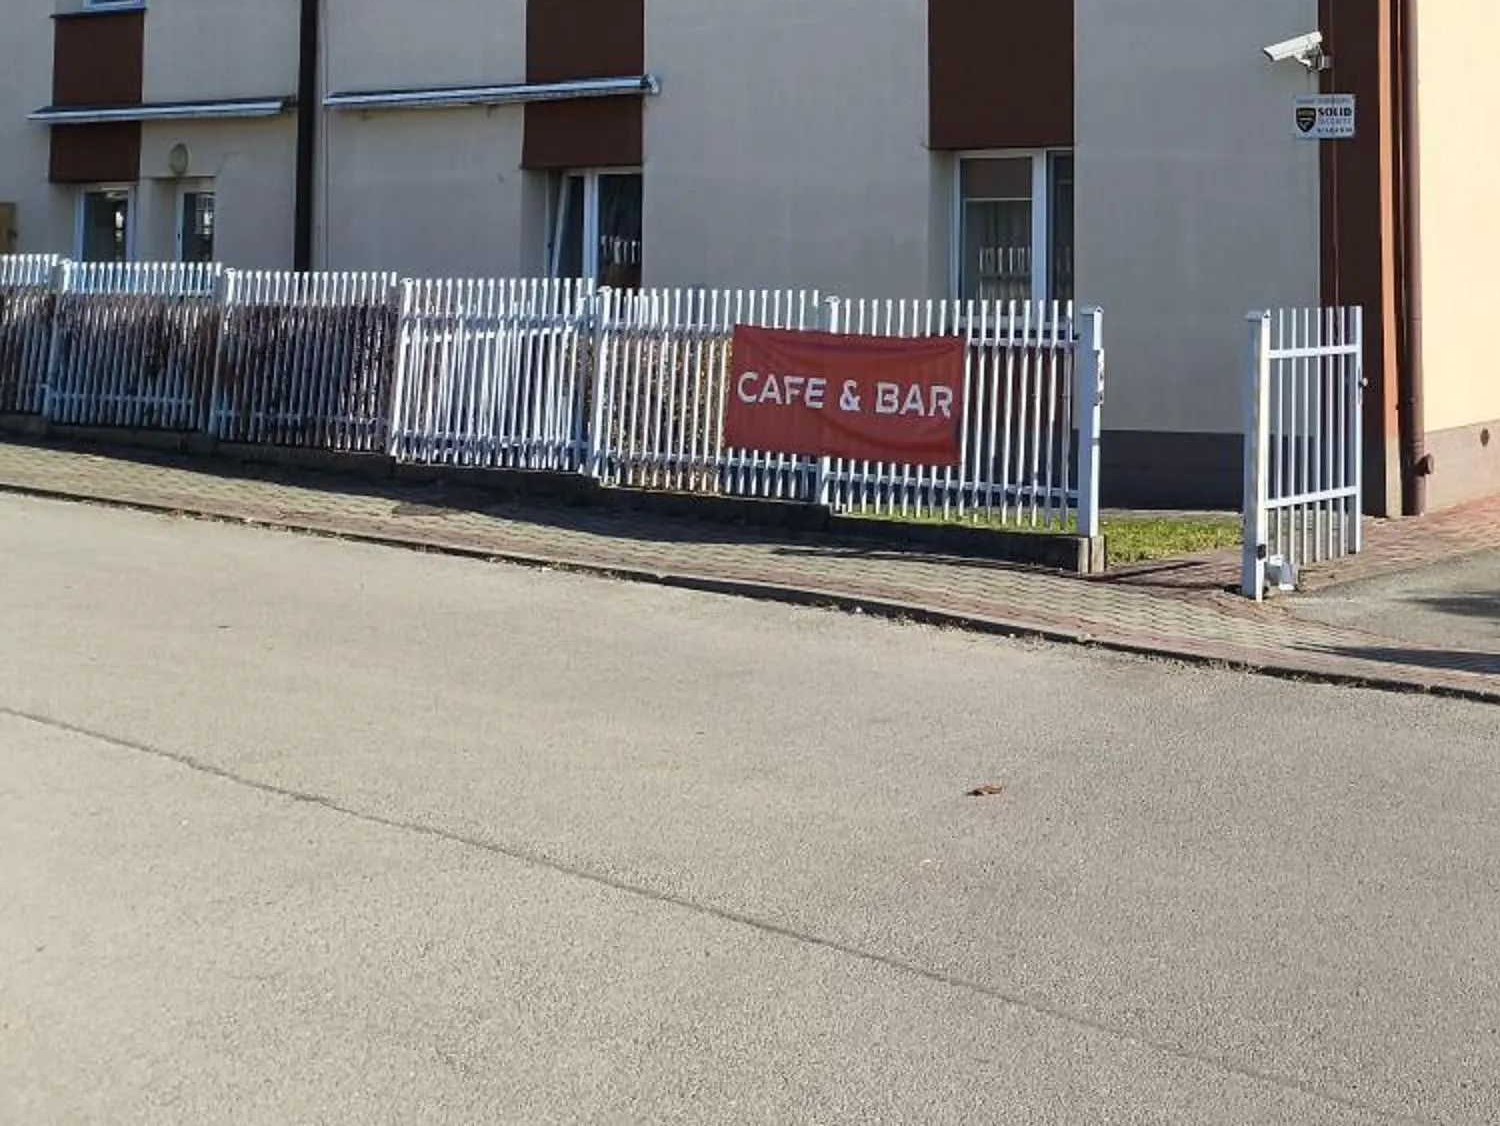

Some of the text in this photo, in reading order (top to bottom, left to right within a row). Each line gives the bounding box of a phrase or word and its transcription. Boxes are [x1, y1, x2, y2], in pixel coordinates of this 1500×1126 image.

[1318, 107, 1352, 117] SOLID
[737, 371, 953, 418] CAFE & BAR
